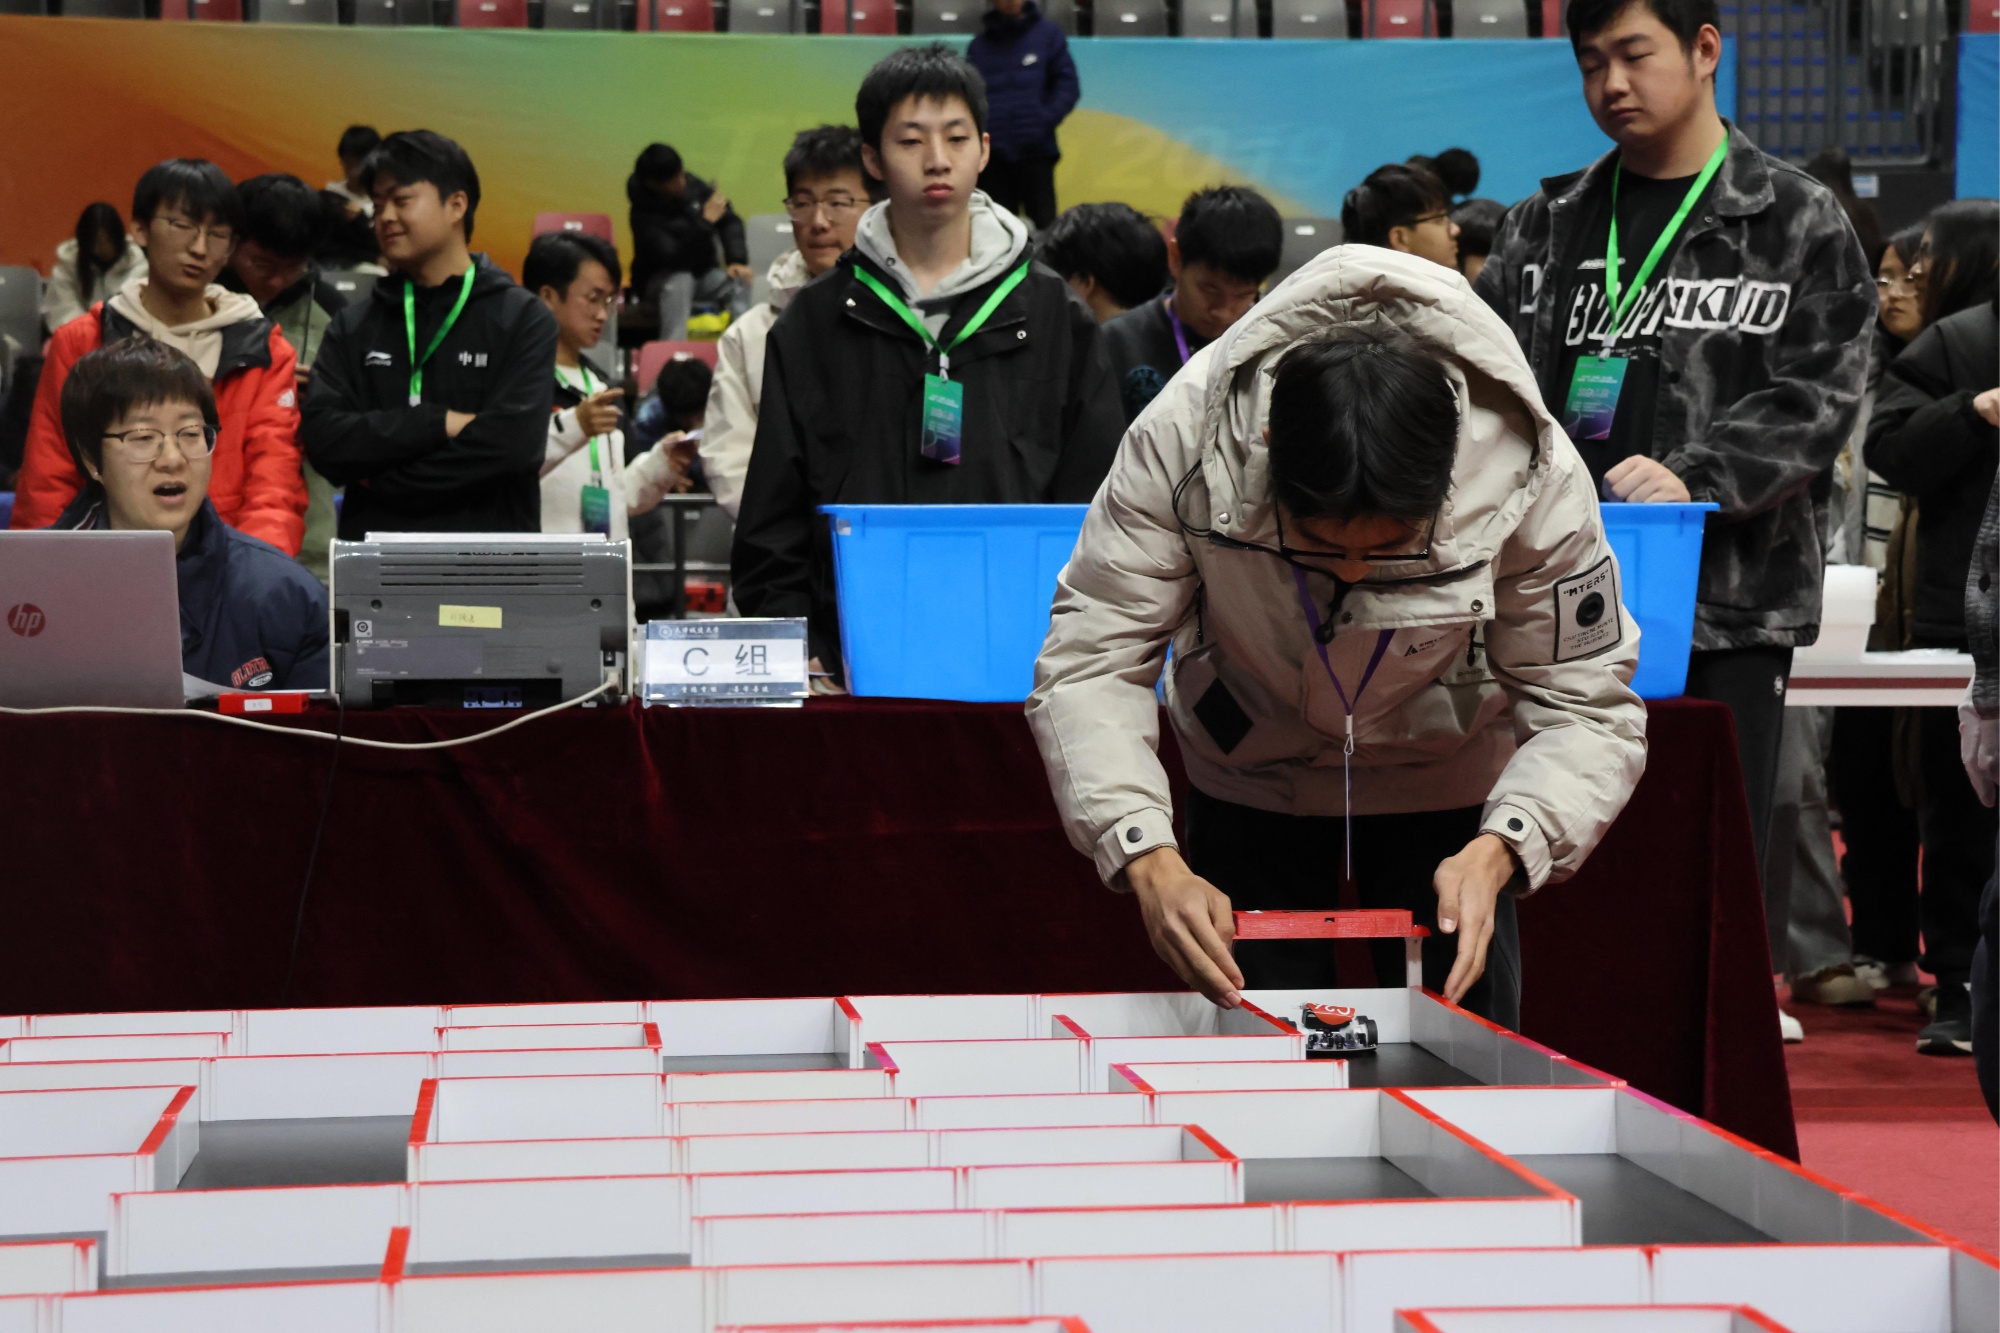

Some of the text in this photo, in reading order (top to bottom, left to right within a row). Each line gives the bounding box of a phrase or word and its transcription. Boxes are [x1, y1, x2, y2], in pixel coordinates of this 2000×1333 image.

[11, 603, 43, 637] hp
[683, 644, 772, 676] C 组
